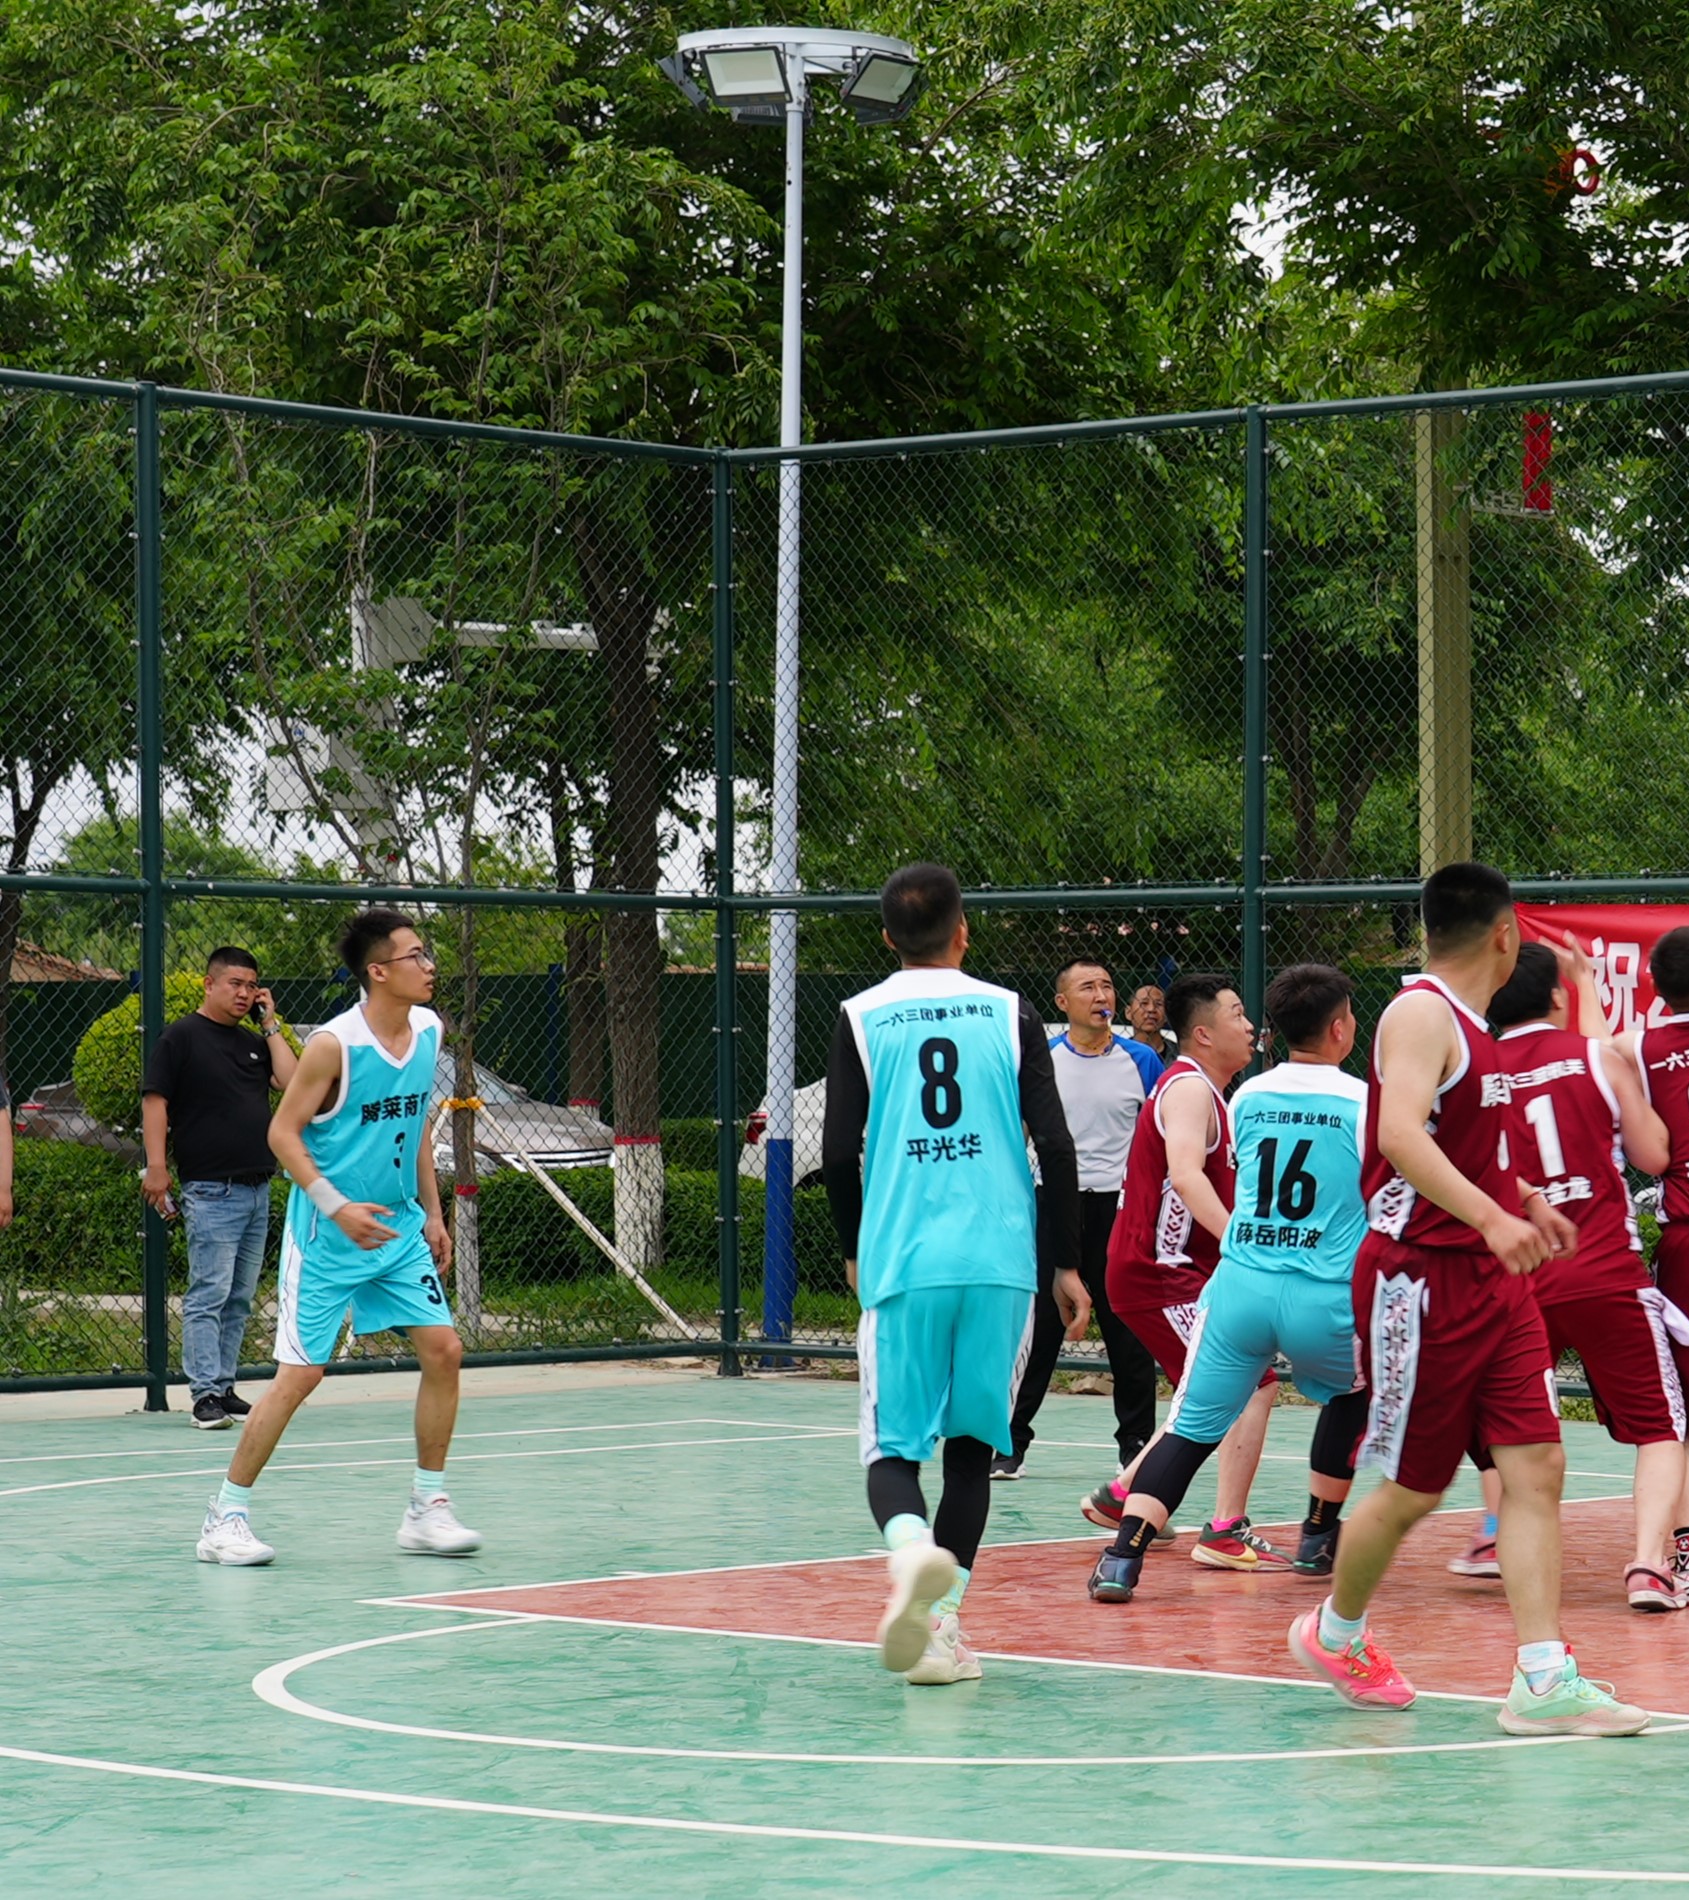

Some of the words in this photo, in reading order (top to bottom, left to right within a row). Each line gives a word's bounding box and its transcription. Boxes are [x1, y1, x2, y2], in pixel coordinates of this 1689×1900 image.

[876, 1003, 994, 1028] 一六三团事业单位
[919, 1037, 962, 1129] 8
[907, 1133, 982, 1163] 平光华
[1244, 1111, 1342, 1129] 一六三团事业单位
[1524, 1093, 1566, 1178] 1
[1254, 1137, 1317, 1222] 16
